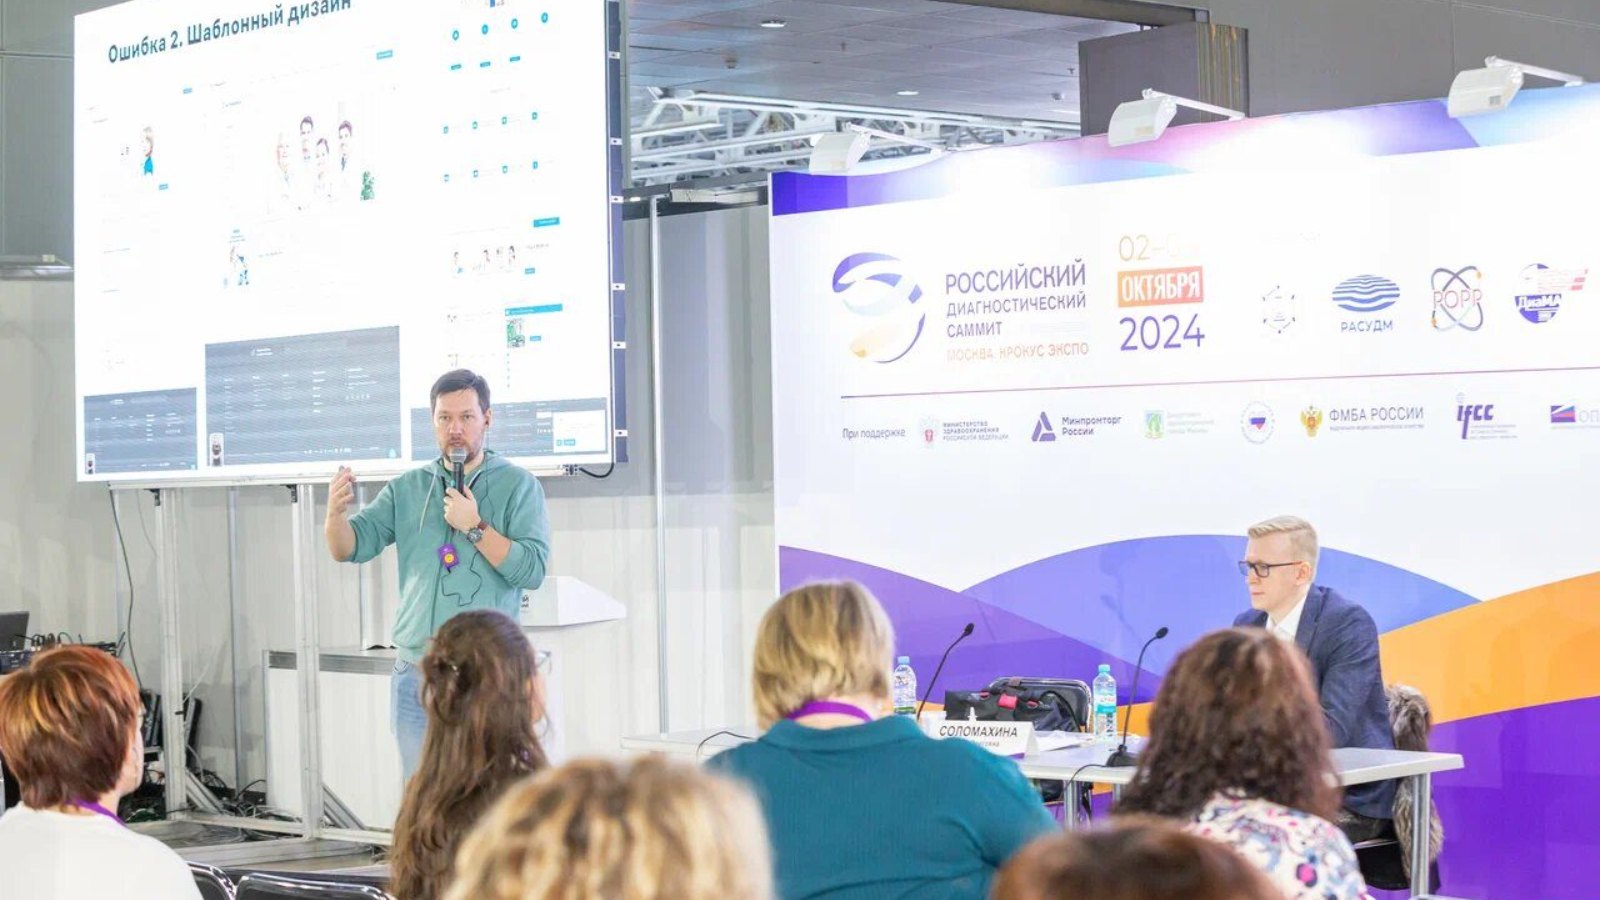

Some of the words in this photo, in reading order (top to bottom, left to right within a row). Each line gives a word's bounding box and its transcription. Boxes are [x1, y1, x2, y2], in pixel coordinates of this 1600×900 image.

[108, 36, 166, 63] Ошибка
[170, 31, 183, 49] 2.
[187, 5, 283, 45] Шаблонный
[945, 258, 1087, 296] РОССИЙСКИЙ
[1121, 270, 1201, 302] ОКТЯБРЯ
[946, 291, 1087, 318] ДИАГНОСТИЧЕСКИЙ
[946, 321, 1003, 338] САММИТ
[1119, 313, 1206, 352] 2024
[1340, 320, 1394, 333] РАСУДМ
[999, 344, 1046, 360] КРОКУС
[1048, 341, 1090, 358] ЭКСПО
[1062, 416, 1122, 427] Минпромторг
[1329, 408, 1367, 422] ФМБА
[1371, 406, 1424, 421] РОССИИ
[842, 428, 859, 440] При
[861, 428, 906, 439] поддержке
[1062, 427, 1094, 436] России
[940, 725, 1018, 738] СОЛОМАХИНА
